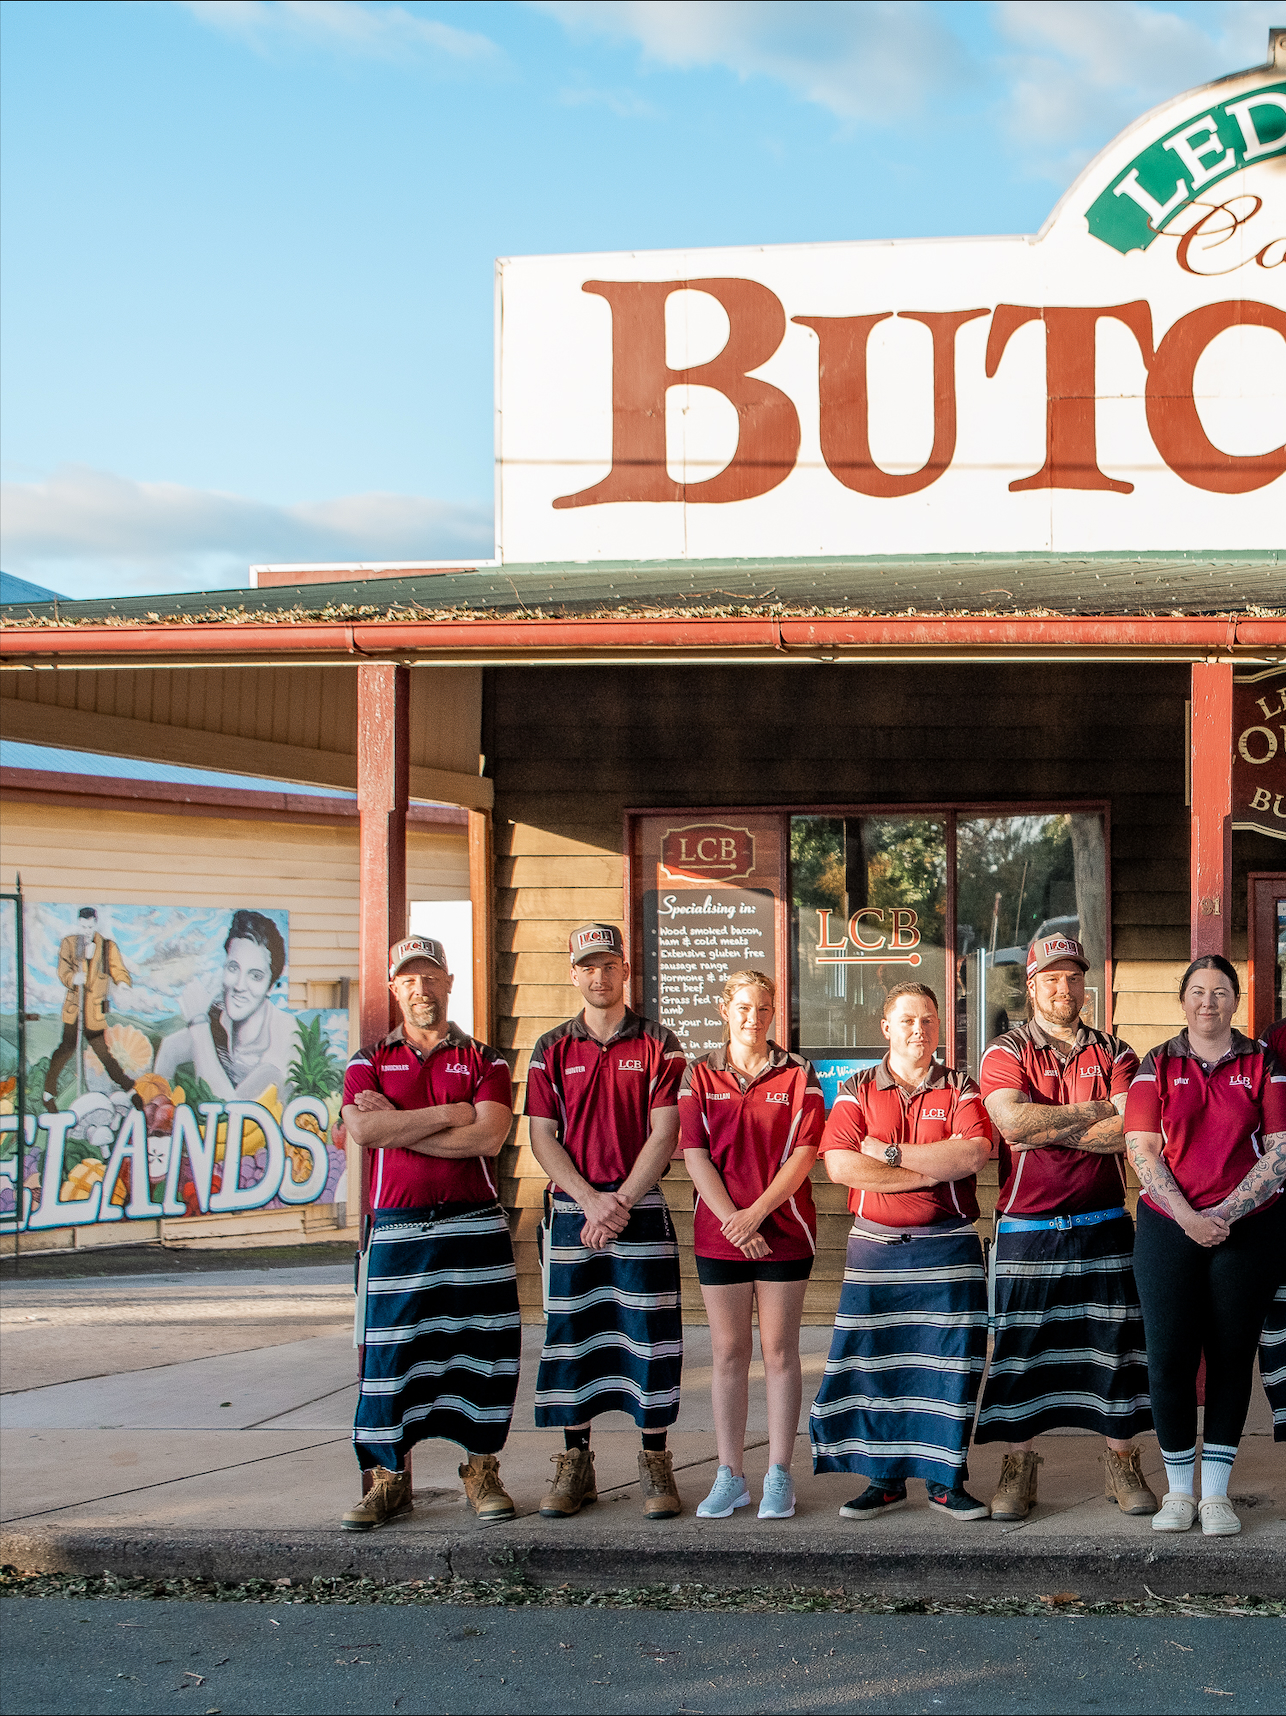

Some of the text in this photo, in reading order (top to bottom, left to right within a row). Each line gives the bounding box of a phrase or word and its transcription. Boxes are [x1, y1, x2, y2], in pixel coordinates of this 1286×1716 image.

[678, 837, 738, 863] LCB
[657, 894, 757, 920] Specialising in:
[659, 925, 688, 936] Wood
[690, 925, 729, 936] smoked
[816, 907, 922, 951] LCB
[658, 936, 750, 947] ham & cold meats
[660, 947, 765, 960] Extensive gluten free
[660, 962, 729, 973] sausage range
[660, 973, 704, 983] Hormone
[706, 972, 716, 983] &
[660, 982, 704, 994] free beef
[661, 994, 690, 1005] Grass
[693, 993, 711, 1006] fed
[660, 1017, 723, 1030] All your low
[703, 1039, 726, 1049] stor
